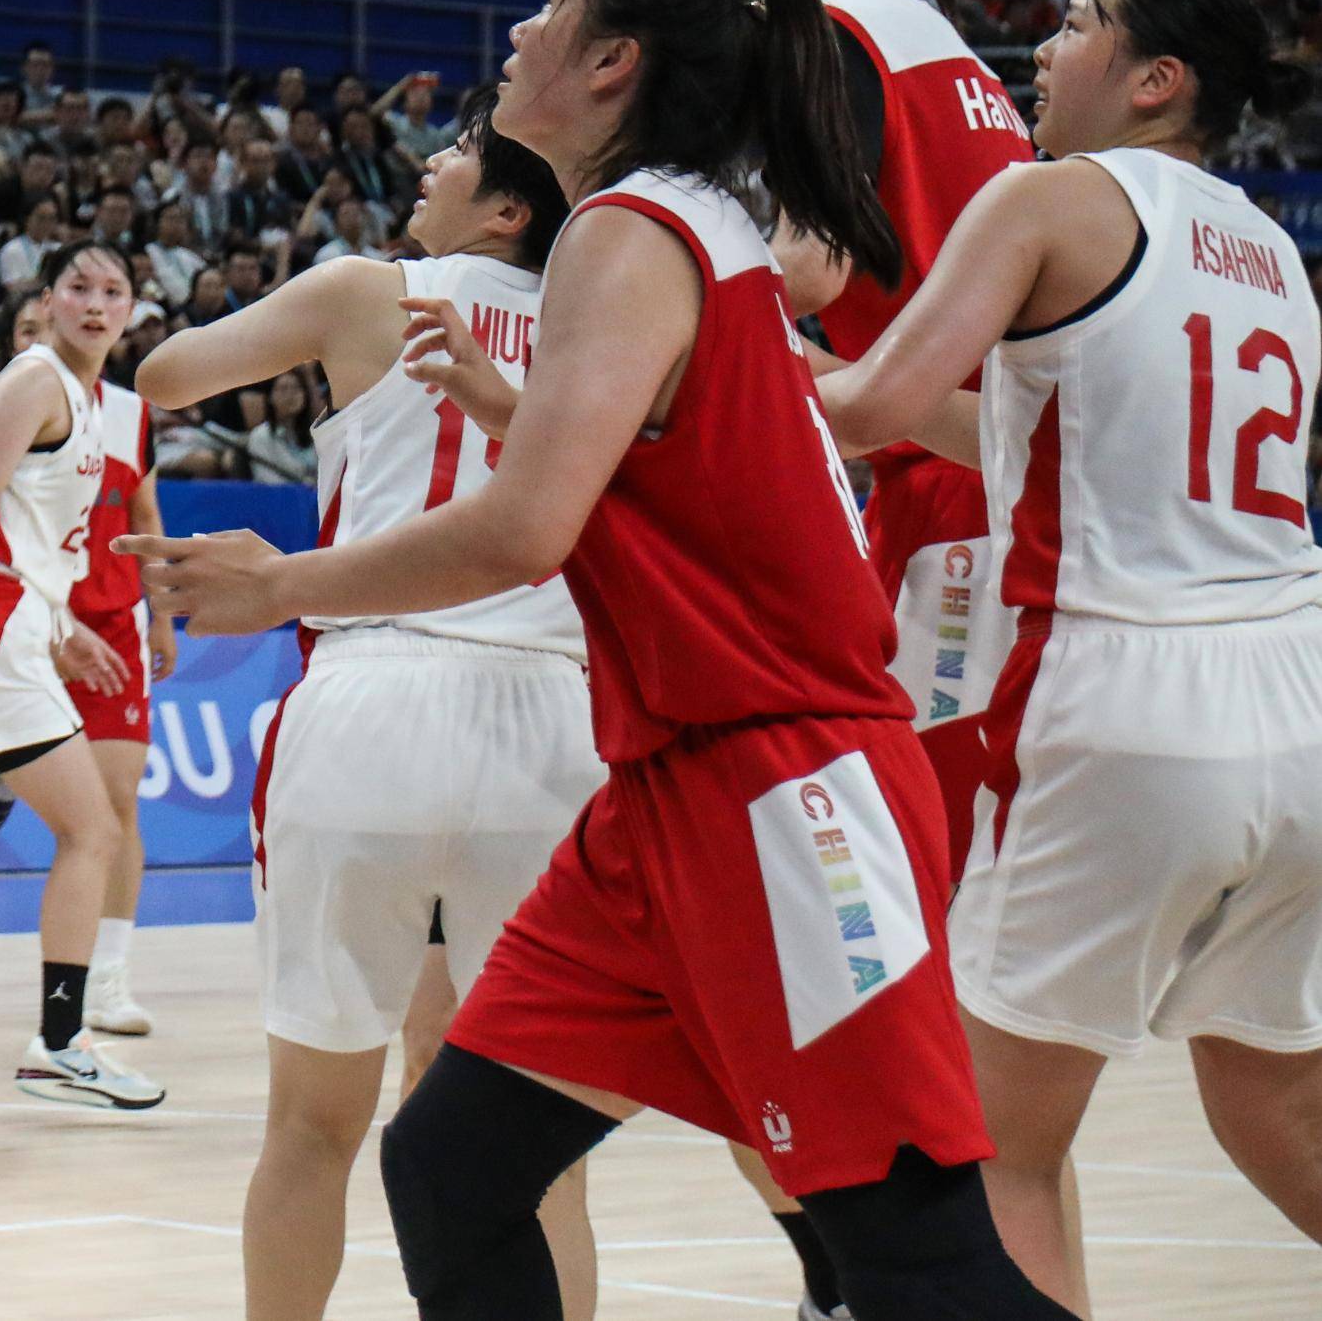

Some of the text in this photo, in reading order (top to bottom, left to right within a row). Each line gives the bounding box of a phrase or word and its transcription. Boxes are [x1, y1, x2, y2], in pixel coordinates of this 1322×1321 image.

[1190, 216, 1287, 300] ASAHINA
[423, 394, 504, 513] 1
[1181, 311, 1306, 531] 12
[929, 543, 974, 721] CHINA
[799, 781, 888, 996] CHINA
